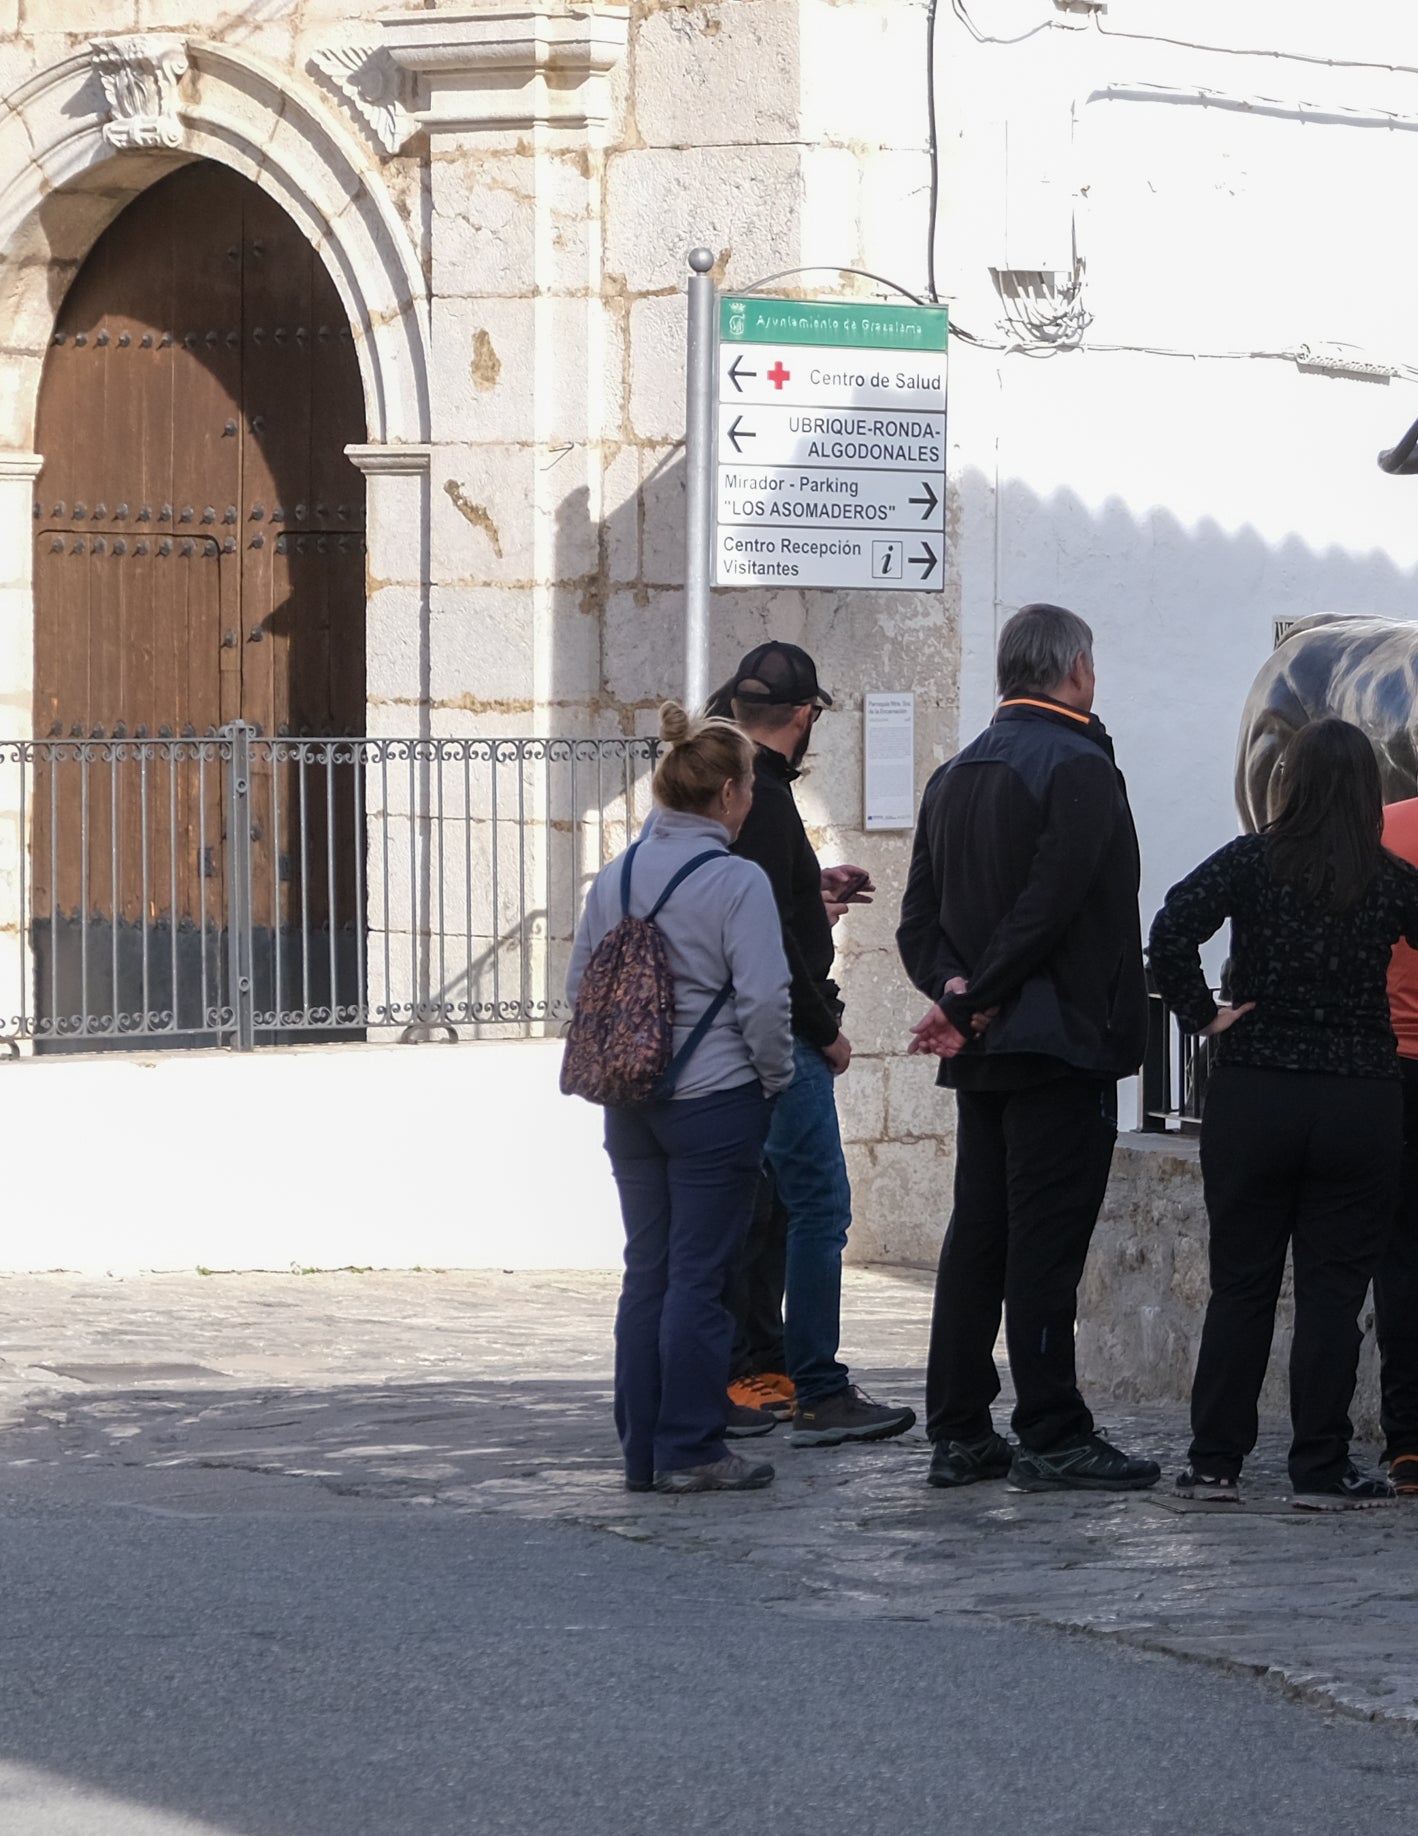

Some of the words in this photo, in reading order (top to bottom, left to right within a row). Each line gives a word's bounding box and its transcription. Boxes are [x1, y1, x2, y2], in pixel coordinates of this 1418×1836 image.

[810, 369, 865, 387] Centro
[870, 371, 889, 388] de
[895, 373, 941, 391] Salud
[789, 416, 940, 438] UBRIQUE-RONDA-
[808, 442, 939, 462] ALGODONALES
[724, 474, 785, 491] Mirador
[799, 476, 859, 497] Parking
[769, 501, 896, 520] ASOMADEROS"
[723, 537, 776, 553] Centro
[780, 538, 861, 558] Recepción
[723, 559, 799, 576] Visitantes
